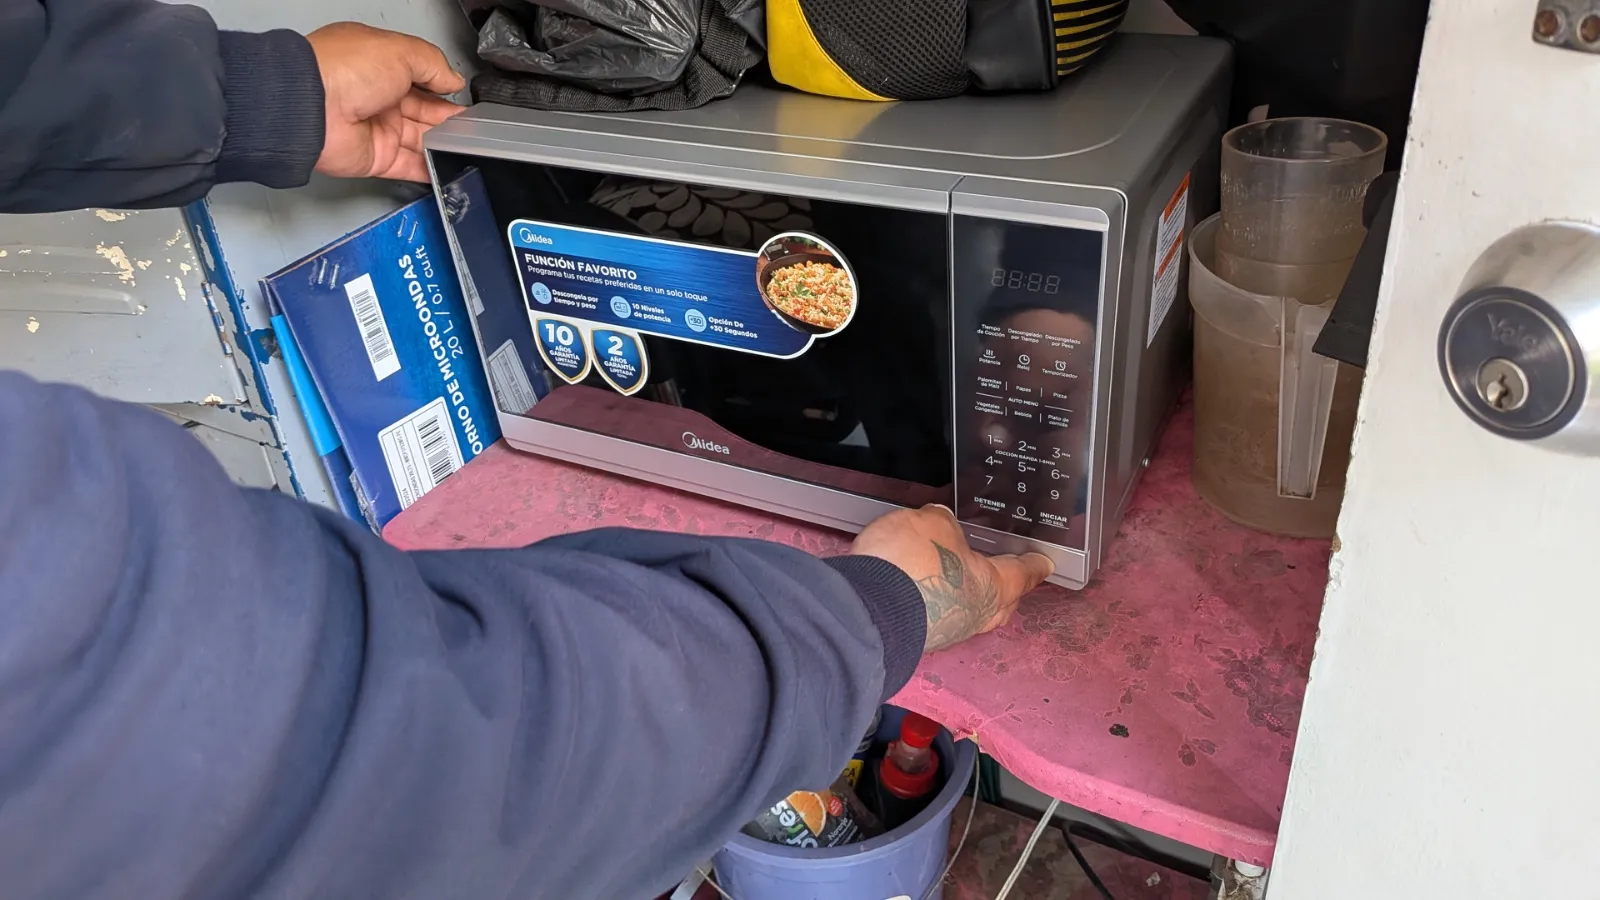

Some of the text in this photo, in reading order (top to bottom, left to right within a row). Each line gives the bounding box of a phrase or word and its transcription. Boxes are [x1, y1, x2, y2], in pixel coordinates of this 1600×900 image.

[519, 227, 553, 245] Midea
[524, 253, 637, 280] FUNCIÓN FAVORITO
[527, 265, 708, 302] Programa tus recetas preferidas en un solo toque
[426, 283, 443, 305] 0.7
[552, 289, 599, 304] Descongela por
[553, 297, 575, 307] tiempo
[580, 302, 597, 310] peso
[640, 303, 665, 314] Niveles
[398, 254, 455, 381] MICROONDAS
[643, 312, 672, 323] potencia
[708, 316, 733, 327] Opción
[443, 319, 454, 334] L
[709, 325, 758, 339] +30 Segundos
[981, 324, 1001, 333] Tiempo
[545, 323, 574, 346] 10
[984, 330, 1006, 338] Cocción
[1007, 328, 1043, 339] Descongelado
[1020, 336, 1040, 344] Tiempo
[1045, 334, 1081, 345] Descongelado
[447, 336, 464, 359] 20
[554, 345, 572, 354] AÑOS
[607, 335, 623, 356] 2
[549, 350, 581, 361] GARANTÍA
[609, 356, 628, 364] AÑOS
[603, 360, 636, 372] GARANTÍA
[978, 357, 1001, 366] Potencia
[1042, 368, 1078, 379] Temporizador
[446, 378, 465, 407] DE
[1015, 385, 1032, 393] Papas
[974, 405, 1004, 415] Congelados
[976, 401, 1000, 410] Vegetales
[1014, 410, 1033, 418] Bebida
[457, 405, 483, 455] ORNO
[682, 431, 730, 455] Midea
[1018, 440, 1027, 452] 2
[995, 449, 1019, 459] COCCIÓN
[1018, 453, 1038, 463] RÁPIDA
[1052, 446, 1061, 459] 3
[985, 455, 994, 466] 4
[1017, 461, 1027, 473] 5
[985, 475, 994, 485] 7
[1051, 469, 1061, 480] 6
[1017, 482, 1027, 493] 8
[1050, 489, 1060, 500] 9
[974, 496, 1006, 509] DETENER
[979, 503, 1000, 512] Cancelar
[1011, 513, 1033, 523] Memoria
[1040, 511, 1068, 523] INICIAR
[827, 817, 848, 840] Naranja
